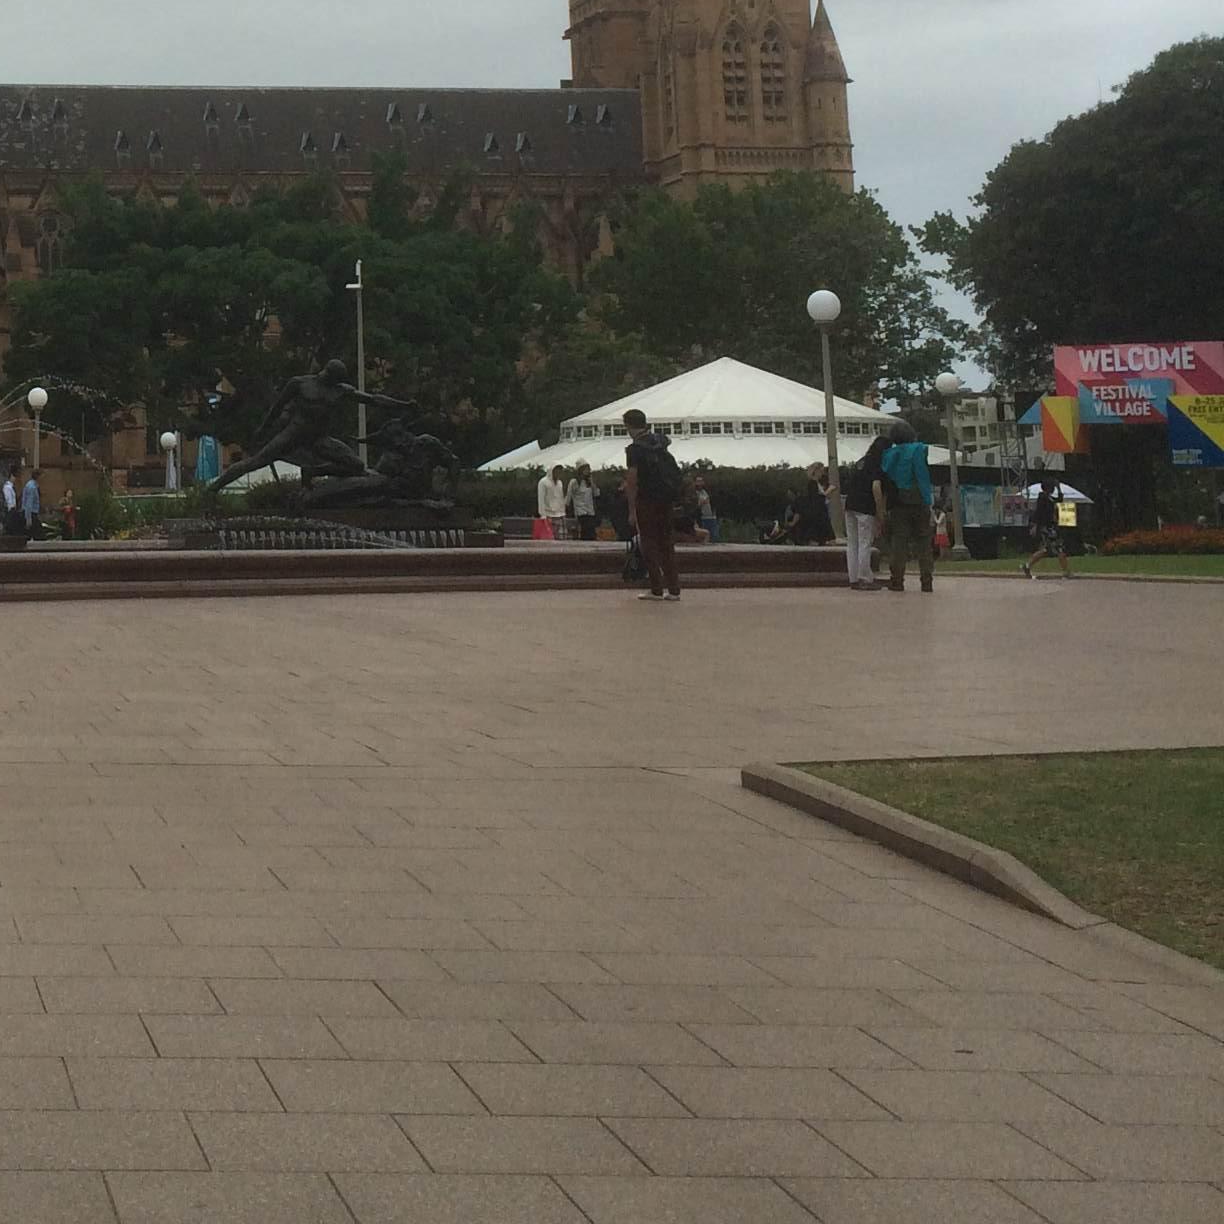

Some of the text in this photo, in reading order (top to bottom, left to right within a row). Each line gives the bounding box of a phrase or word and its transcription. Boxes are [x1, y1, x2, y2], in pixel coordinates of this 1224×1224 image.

[1078, 346, 1196, 372] WELCOME
[1092, 384, 1157, 400] FESTIVAL
[1093, 401, 1151, 416] VILLAGE
